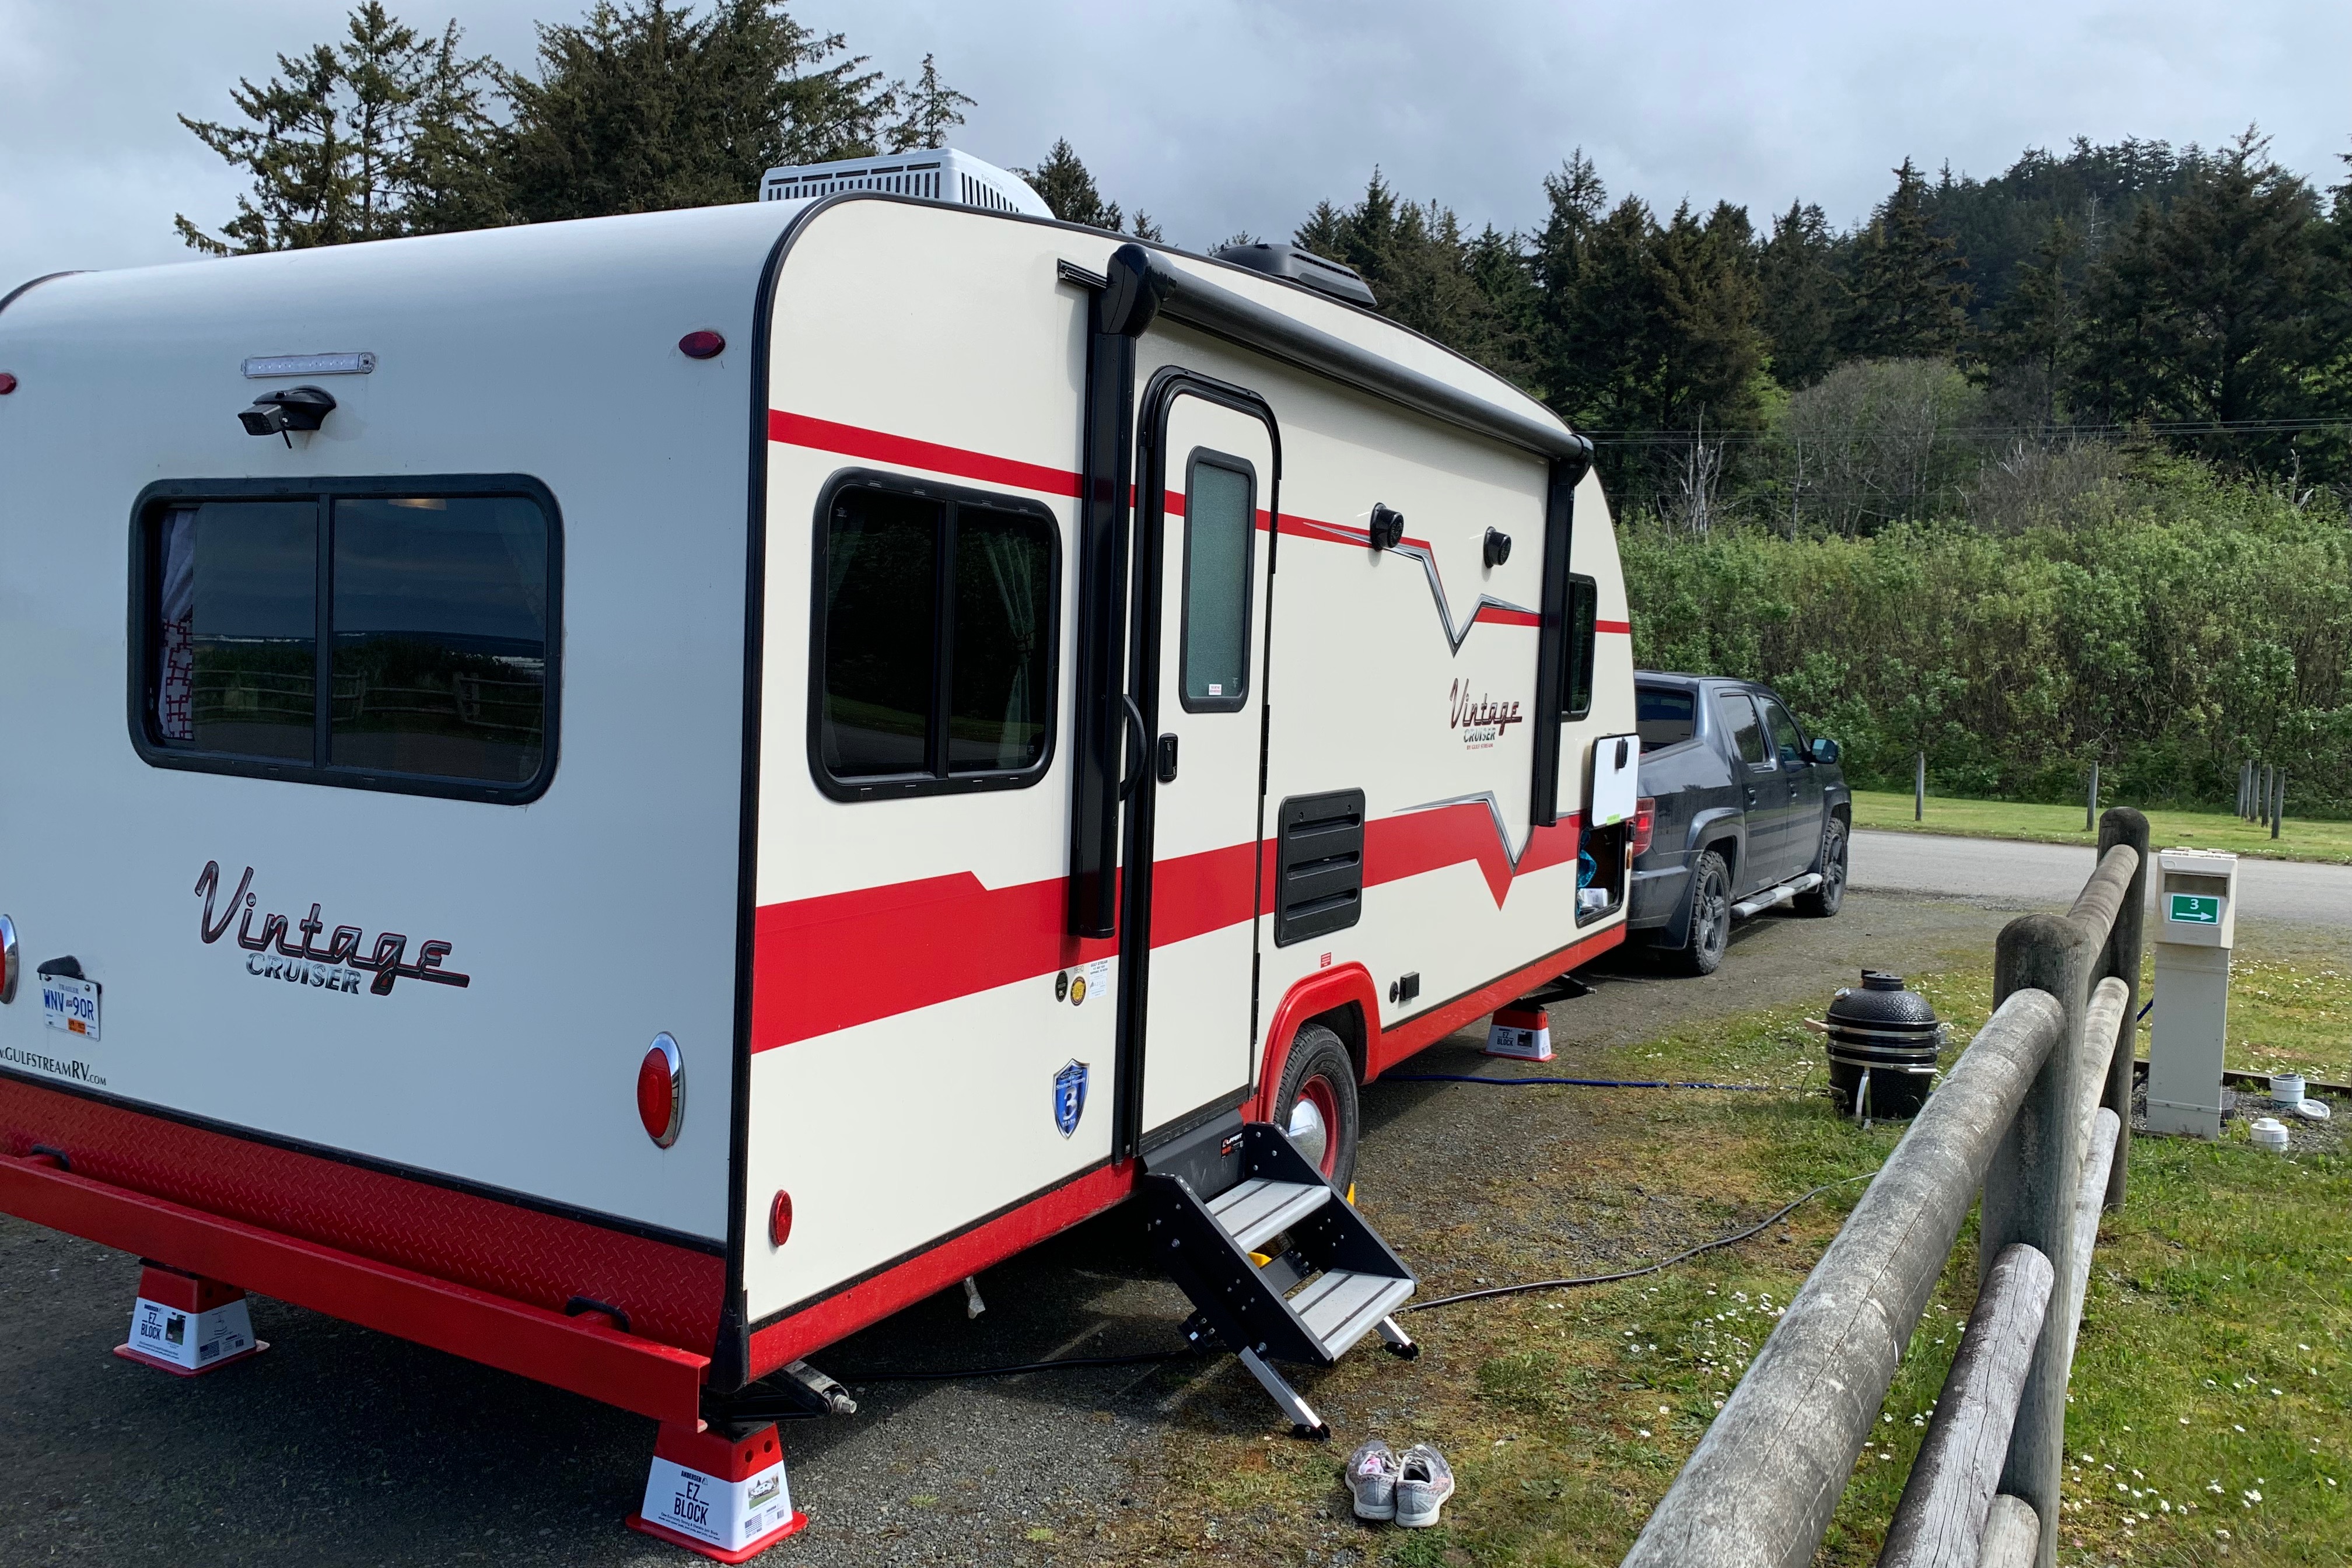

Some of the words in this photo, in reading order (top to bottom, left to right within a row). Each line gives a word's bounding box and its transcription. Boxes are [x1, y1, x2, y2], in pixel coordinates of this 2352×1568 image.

[981, 173, 1004, 192] EVOLUTION
[1450, 677, 1522, 736] Vintage
[1463, 727, 1496, 743] CRUISER
[2190, 898, 2199, 910] 3
[195, 860, 470, 996] Vintage
[246, 952, 362, 995] CRUISER
[43, 988, 64, 1013] WNV
[73, 996, 94, 1021] 90R
[1497, 1038, 1513, 1046] BLOCK
[1063, 1086, 1077, 1120] 3
[148, 1312, 157, 1325] EZ
[141, 1323, 161, 1340] BLOCK
[687, 1481, 700, 1502] EZ
[674, 1497, 708, 1526] BLOCK
